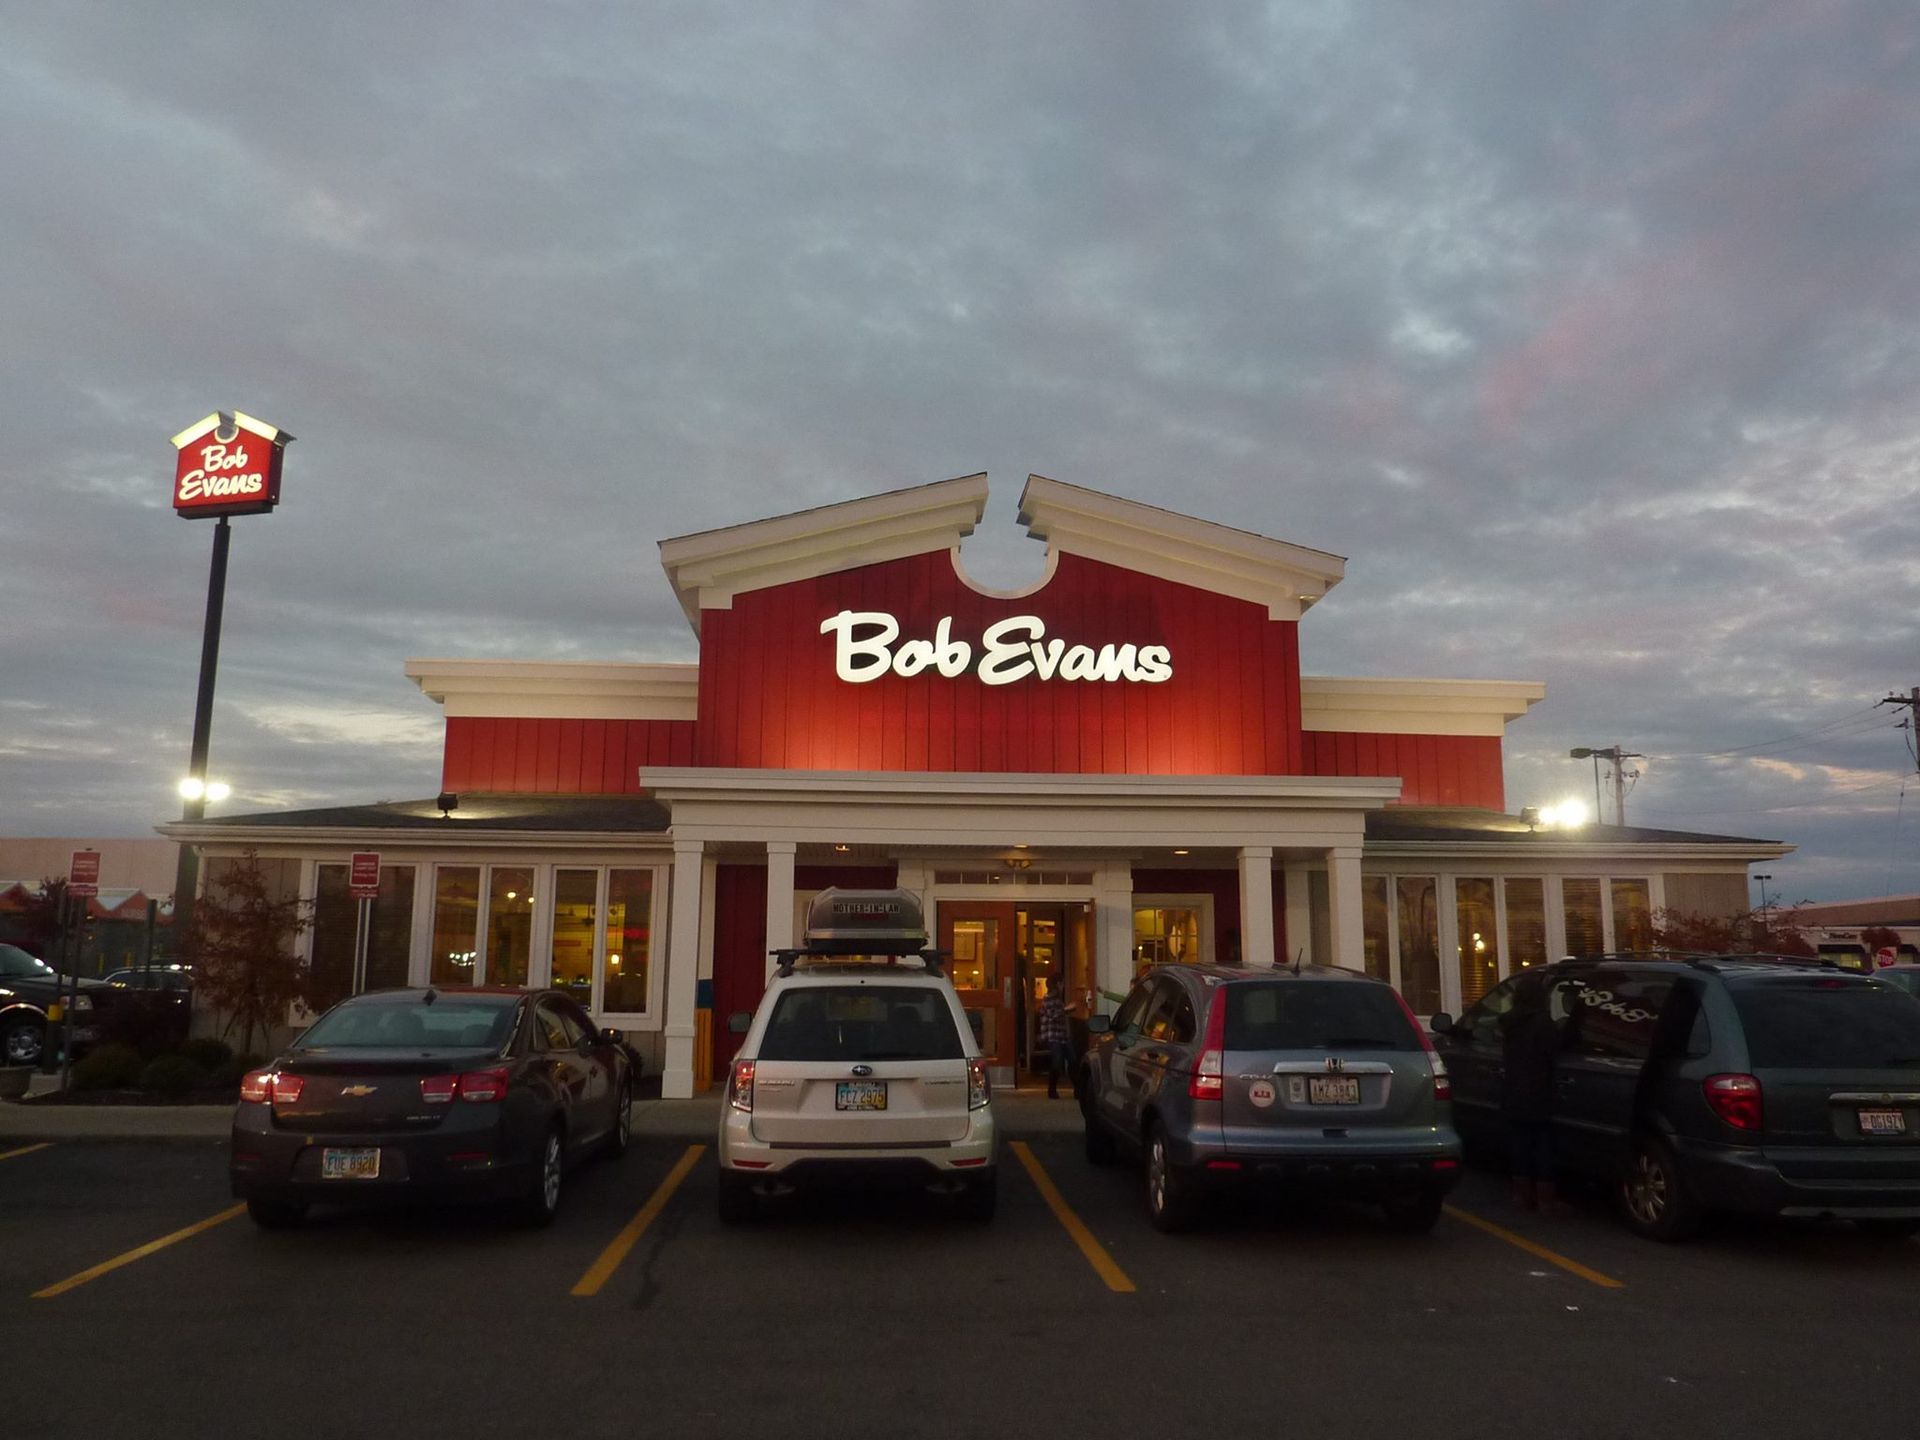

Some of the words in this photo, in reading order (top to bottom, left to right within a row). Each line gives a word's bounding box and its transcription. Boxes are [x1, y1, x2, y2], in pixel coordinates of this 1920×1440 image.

[201, 445, 248, 472] Bob
[178, 469, 263, 501] Evans
[819, 610, 972, 684] Bob
[977, 615, 1173, 686] Evans
[1878, 955, 1894, 965] STOP
[840, 1089, 857, 1104] FCZ
[860, 1088, 884, 1104] 2975
